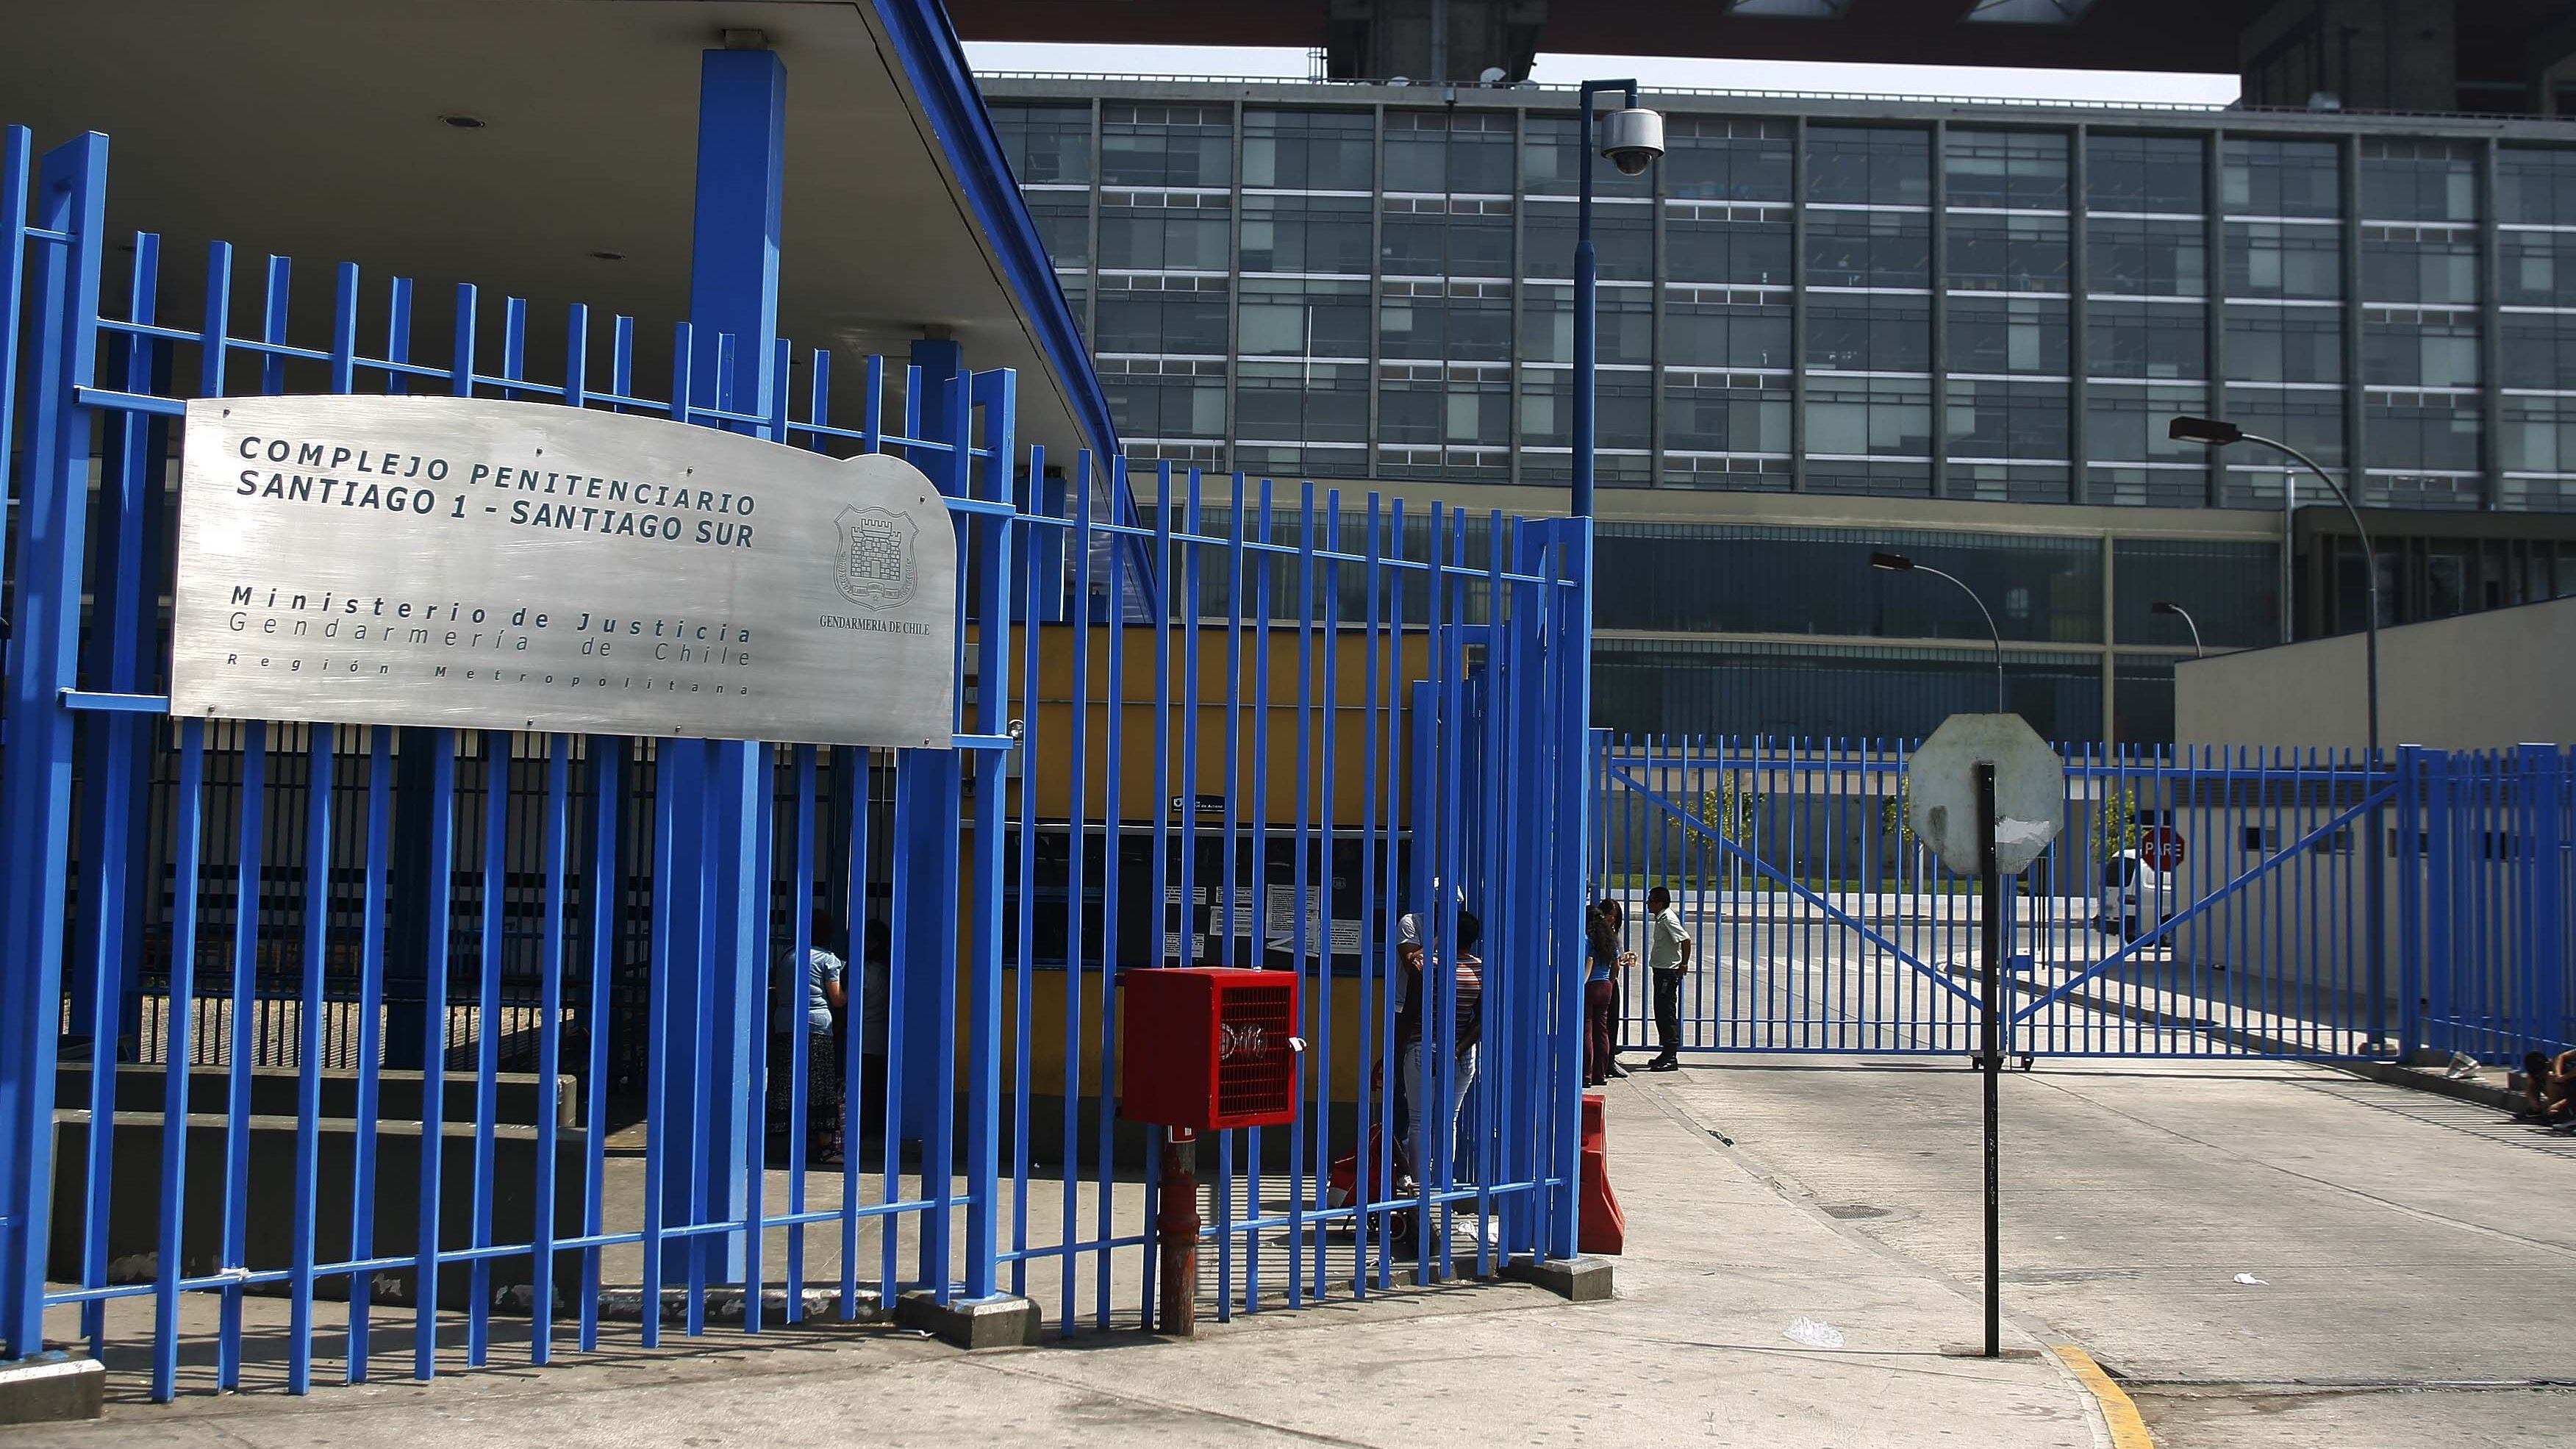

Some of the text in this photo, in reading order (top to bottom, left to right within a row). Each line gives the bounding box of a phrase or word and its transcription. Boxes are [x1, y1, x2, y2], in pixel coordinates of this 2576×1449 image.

[240, 436, 755, 516] COMPLEJO PENITENCIARIO
[237, 470, 436, 515] SANTIAGO
[451, 495, 466, 519] 1
[510, 500, 682, 541] SANTIAGO
[695, 520, 754, 548] SUR
[229, 612, 750, 665] Gendarmería de Chile
[231, 585, 750, 643] Ministerio de Justicia
[820, 615, 930, 635] GENDARMERIA DE CHILE
[227, 653, 748, 695] Región Metropolitana
[2145, 841, 2182, 856] PRE
